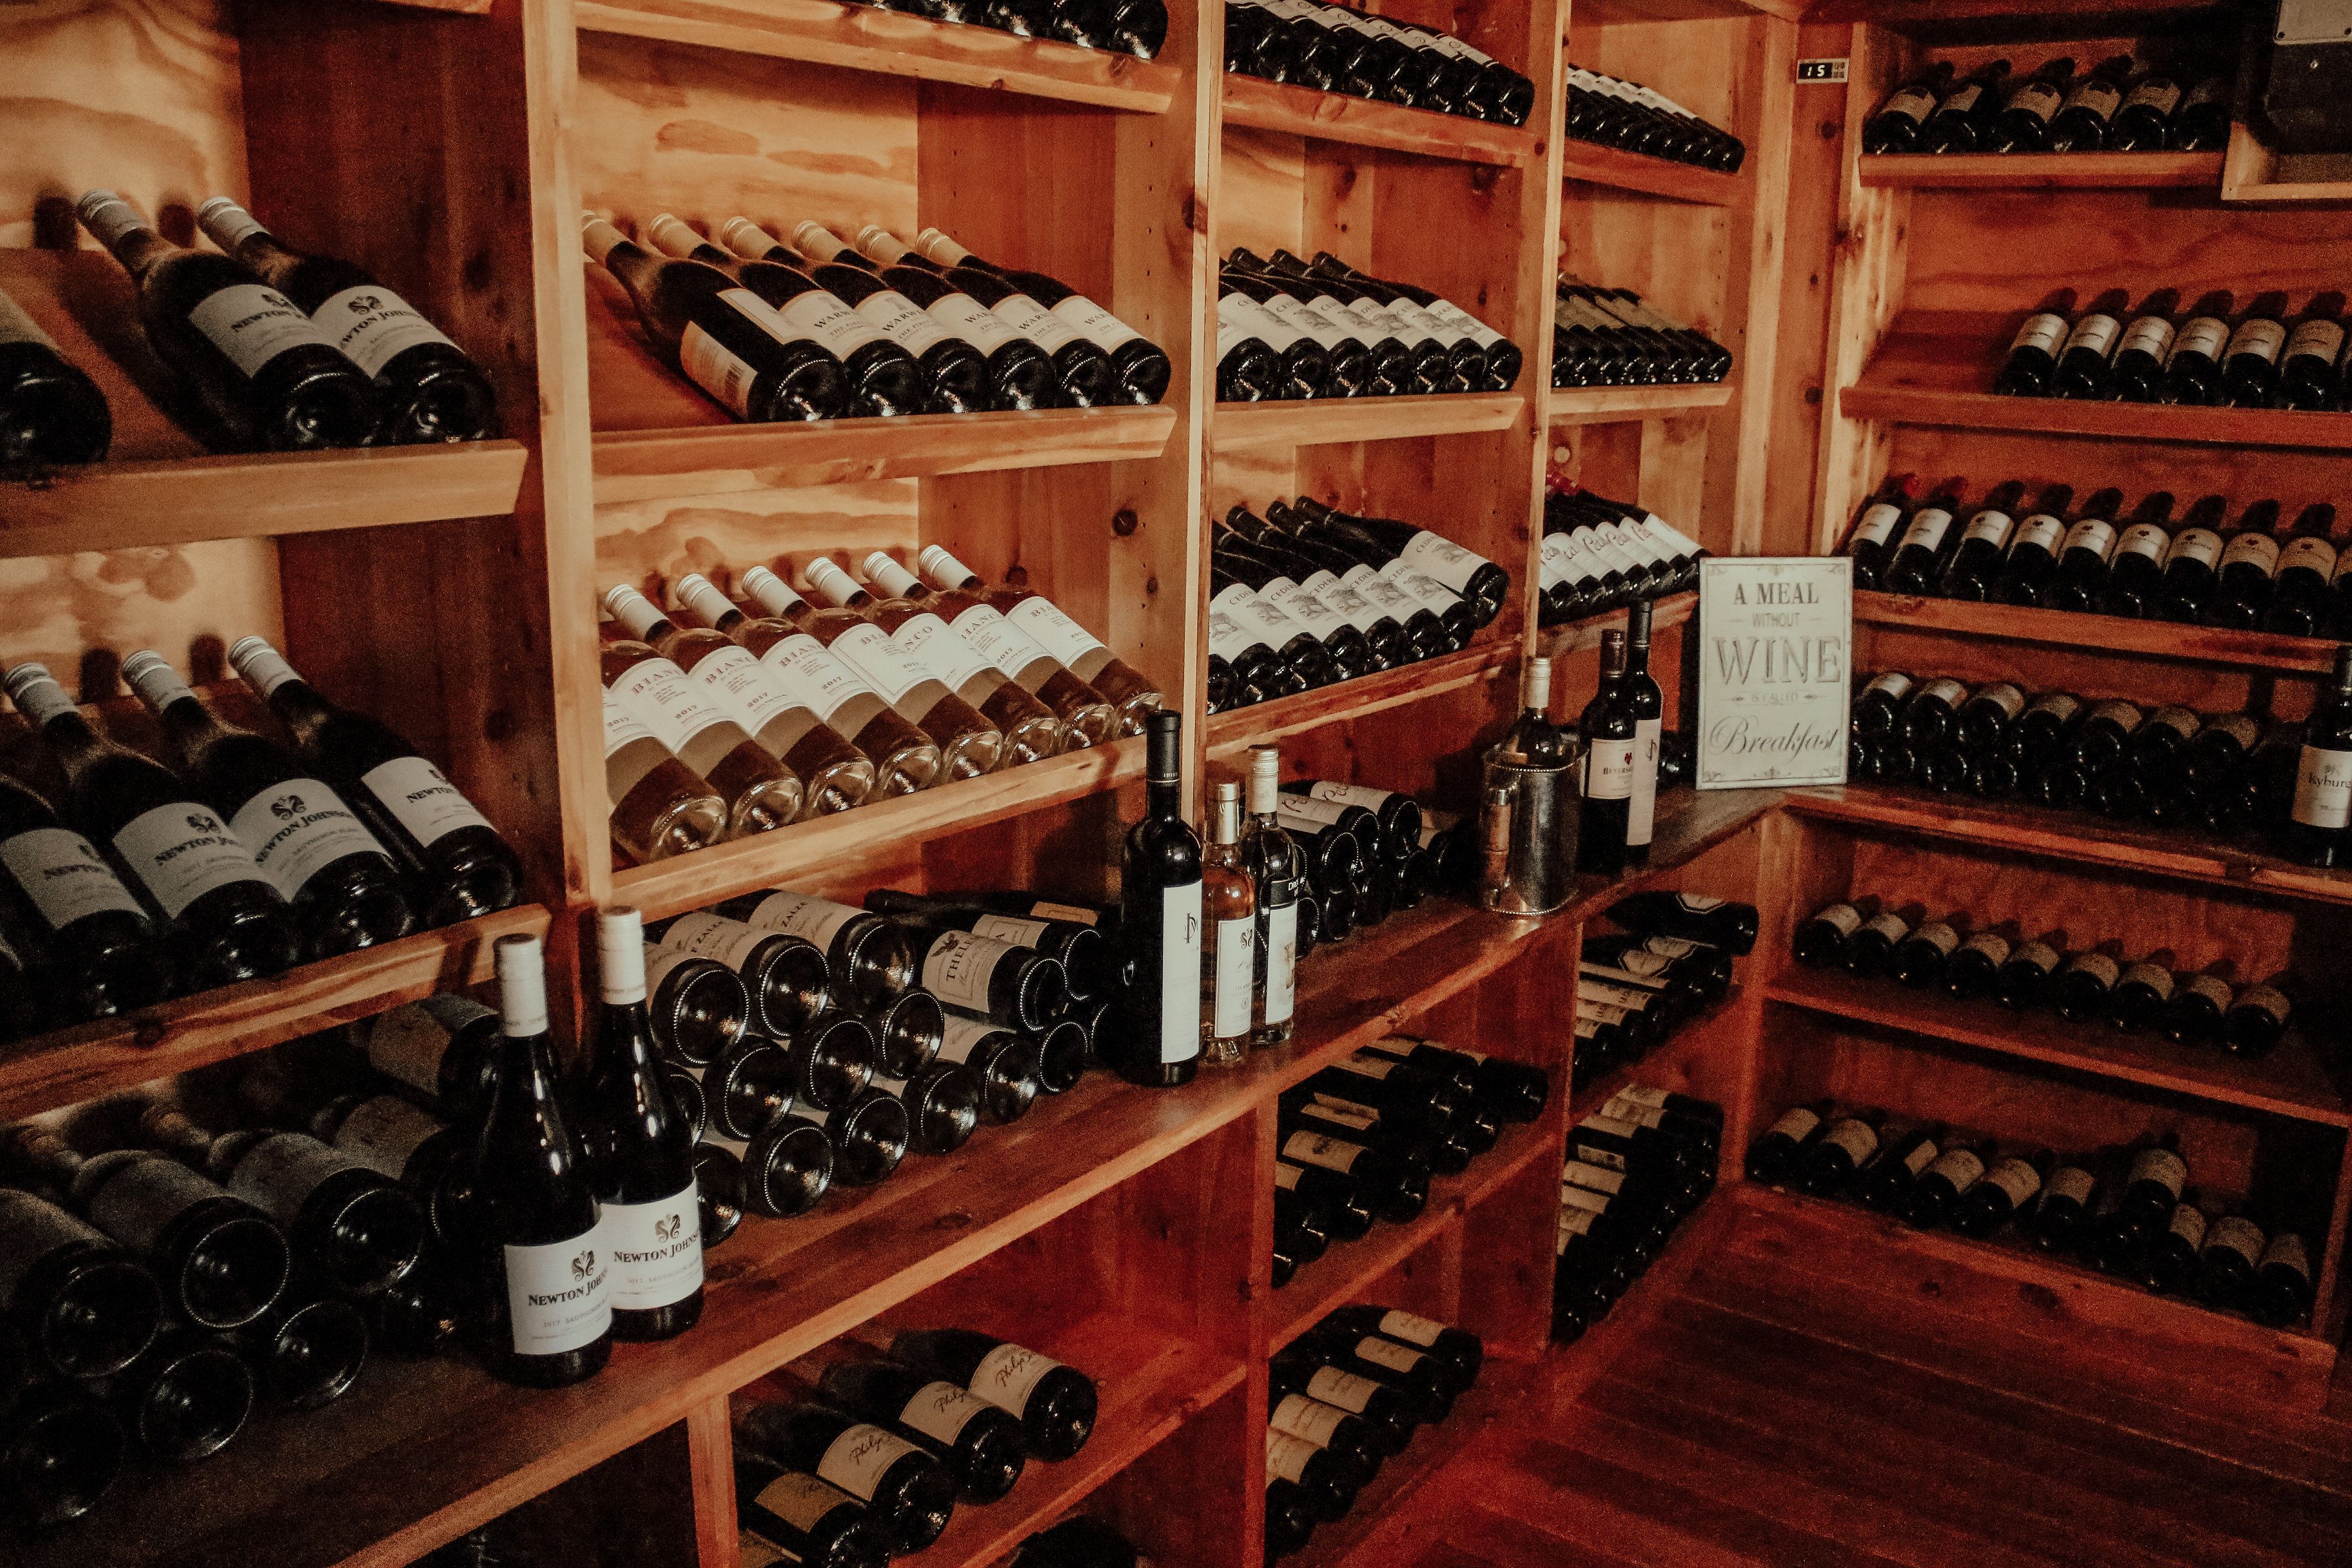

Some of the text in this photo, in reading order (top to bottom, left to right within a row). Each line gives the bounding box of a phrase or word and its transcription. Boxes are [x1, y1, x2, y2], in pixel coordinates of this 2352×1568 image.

[1733, 581, 1820, 605] A MEAL
[1752, 612, 1801, 629] WITHOUT
[996, 647, 1013, 664] 2017
[1711, 635, 1842, 685] WINE
[821, 676, 843, 691] 2017
[746, 691, 769, 708] 2017
[674, 704, 698, 719] 2017
[1708, 715, 1839, 764] Breakfast
[613, 1247, 668, 1264] NEWTON
[527, 1286, 585, 1307] NEWTON
